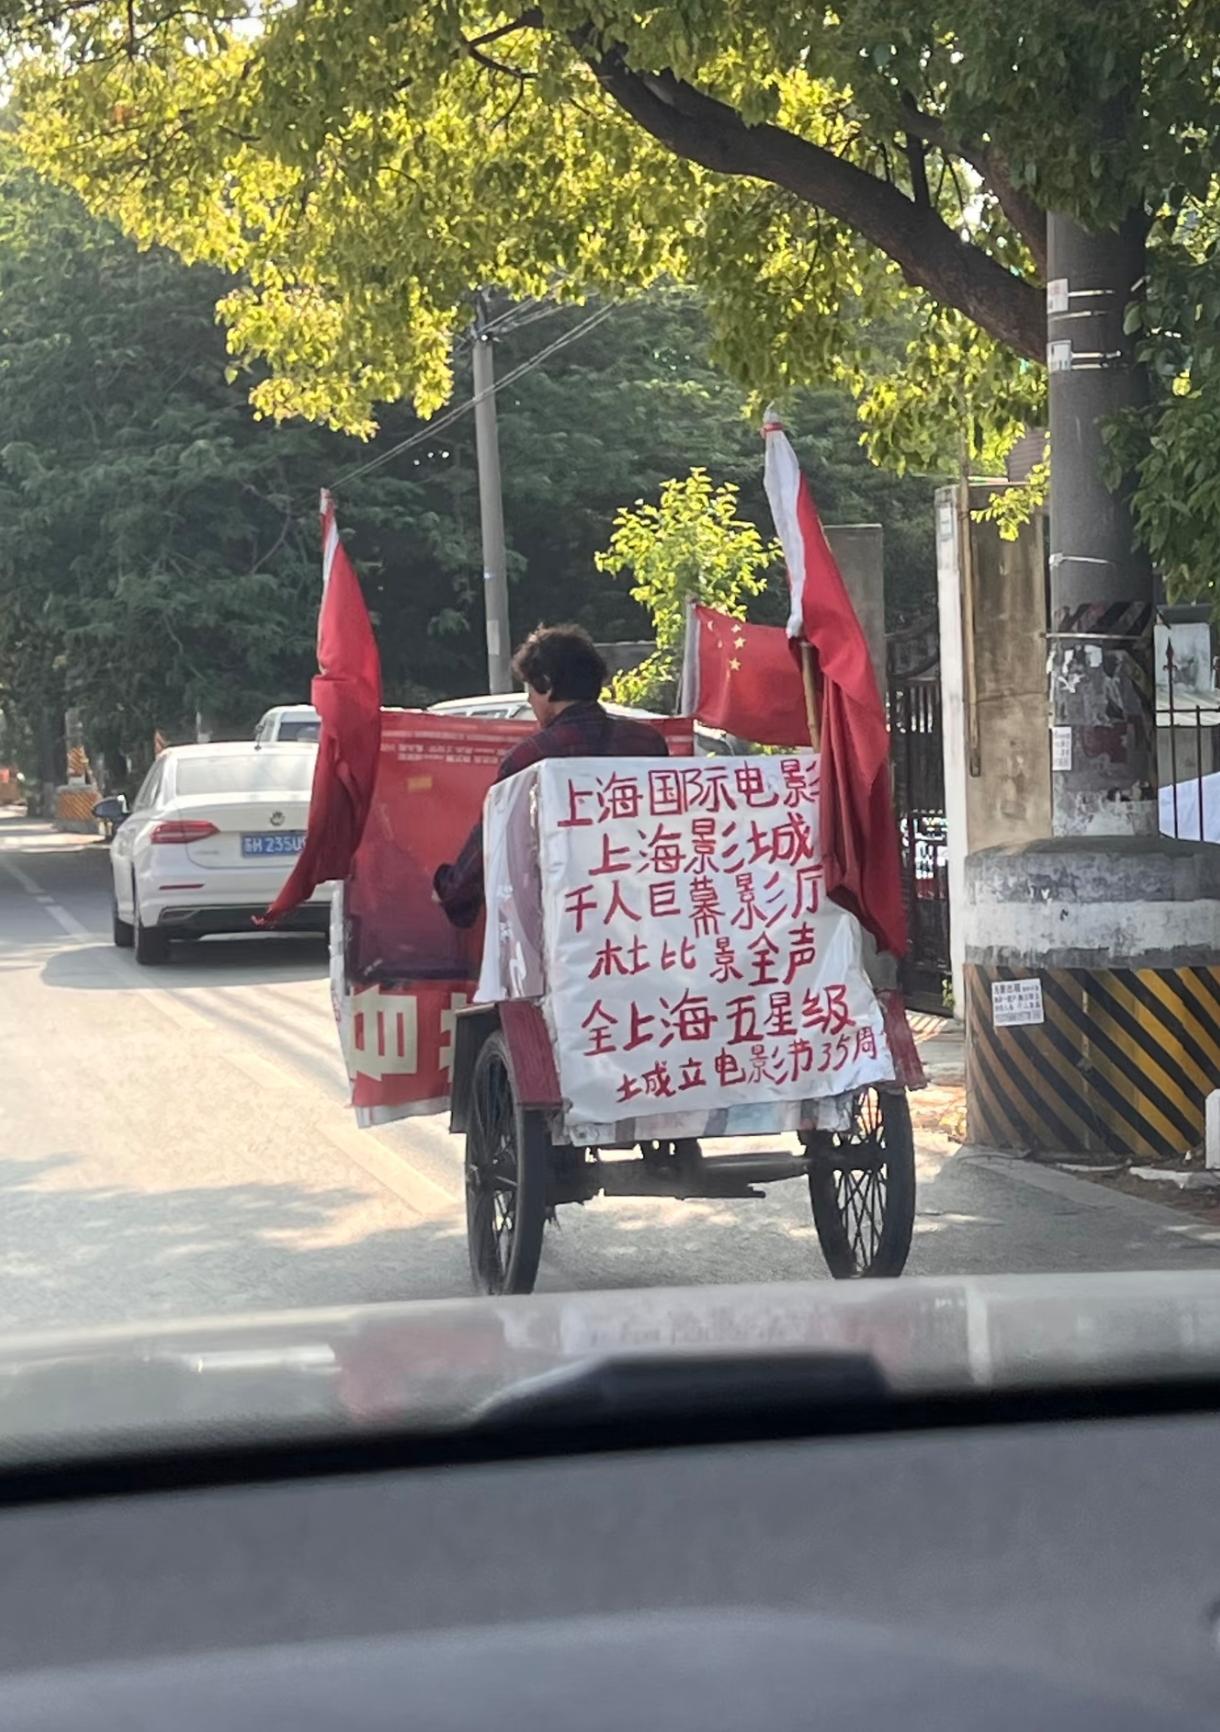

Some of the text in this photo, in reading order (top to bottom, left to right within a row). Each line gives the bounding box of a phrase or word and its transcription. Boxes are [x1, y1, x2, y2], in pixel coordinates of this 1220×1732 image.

[557, 758, 820, 827] 上海国际电影
[588, 812, 815, 876] 上海影城
[564, 864, 824, 938] 千人巨幕影厅
[587, 921, 816, 986] 杜比景全声
[580, 984, 856, 1057] 全上海五星级
